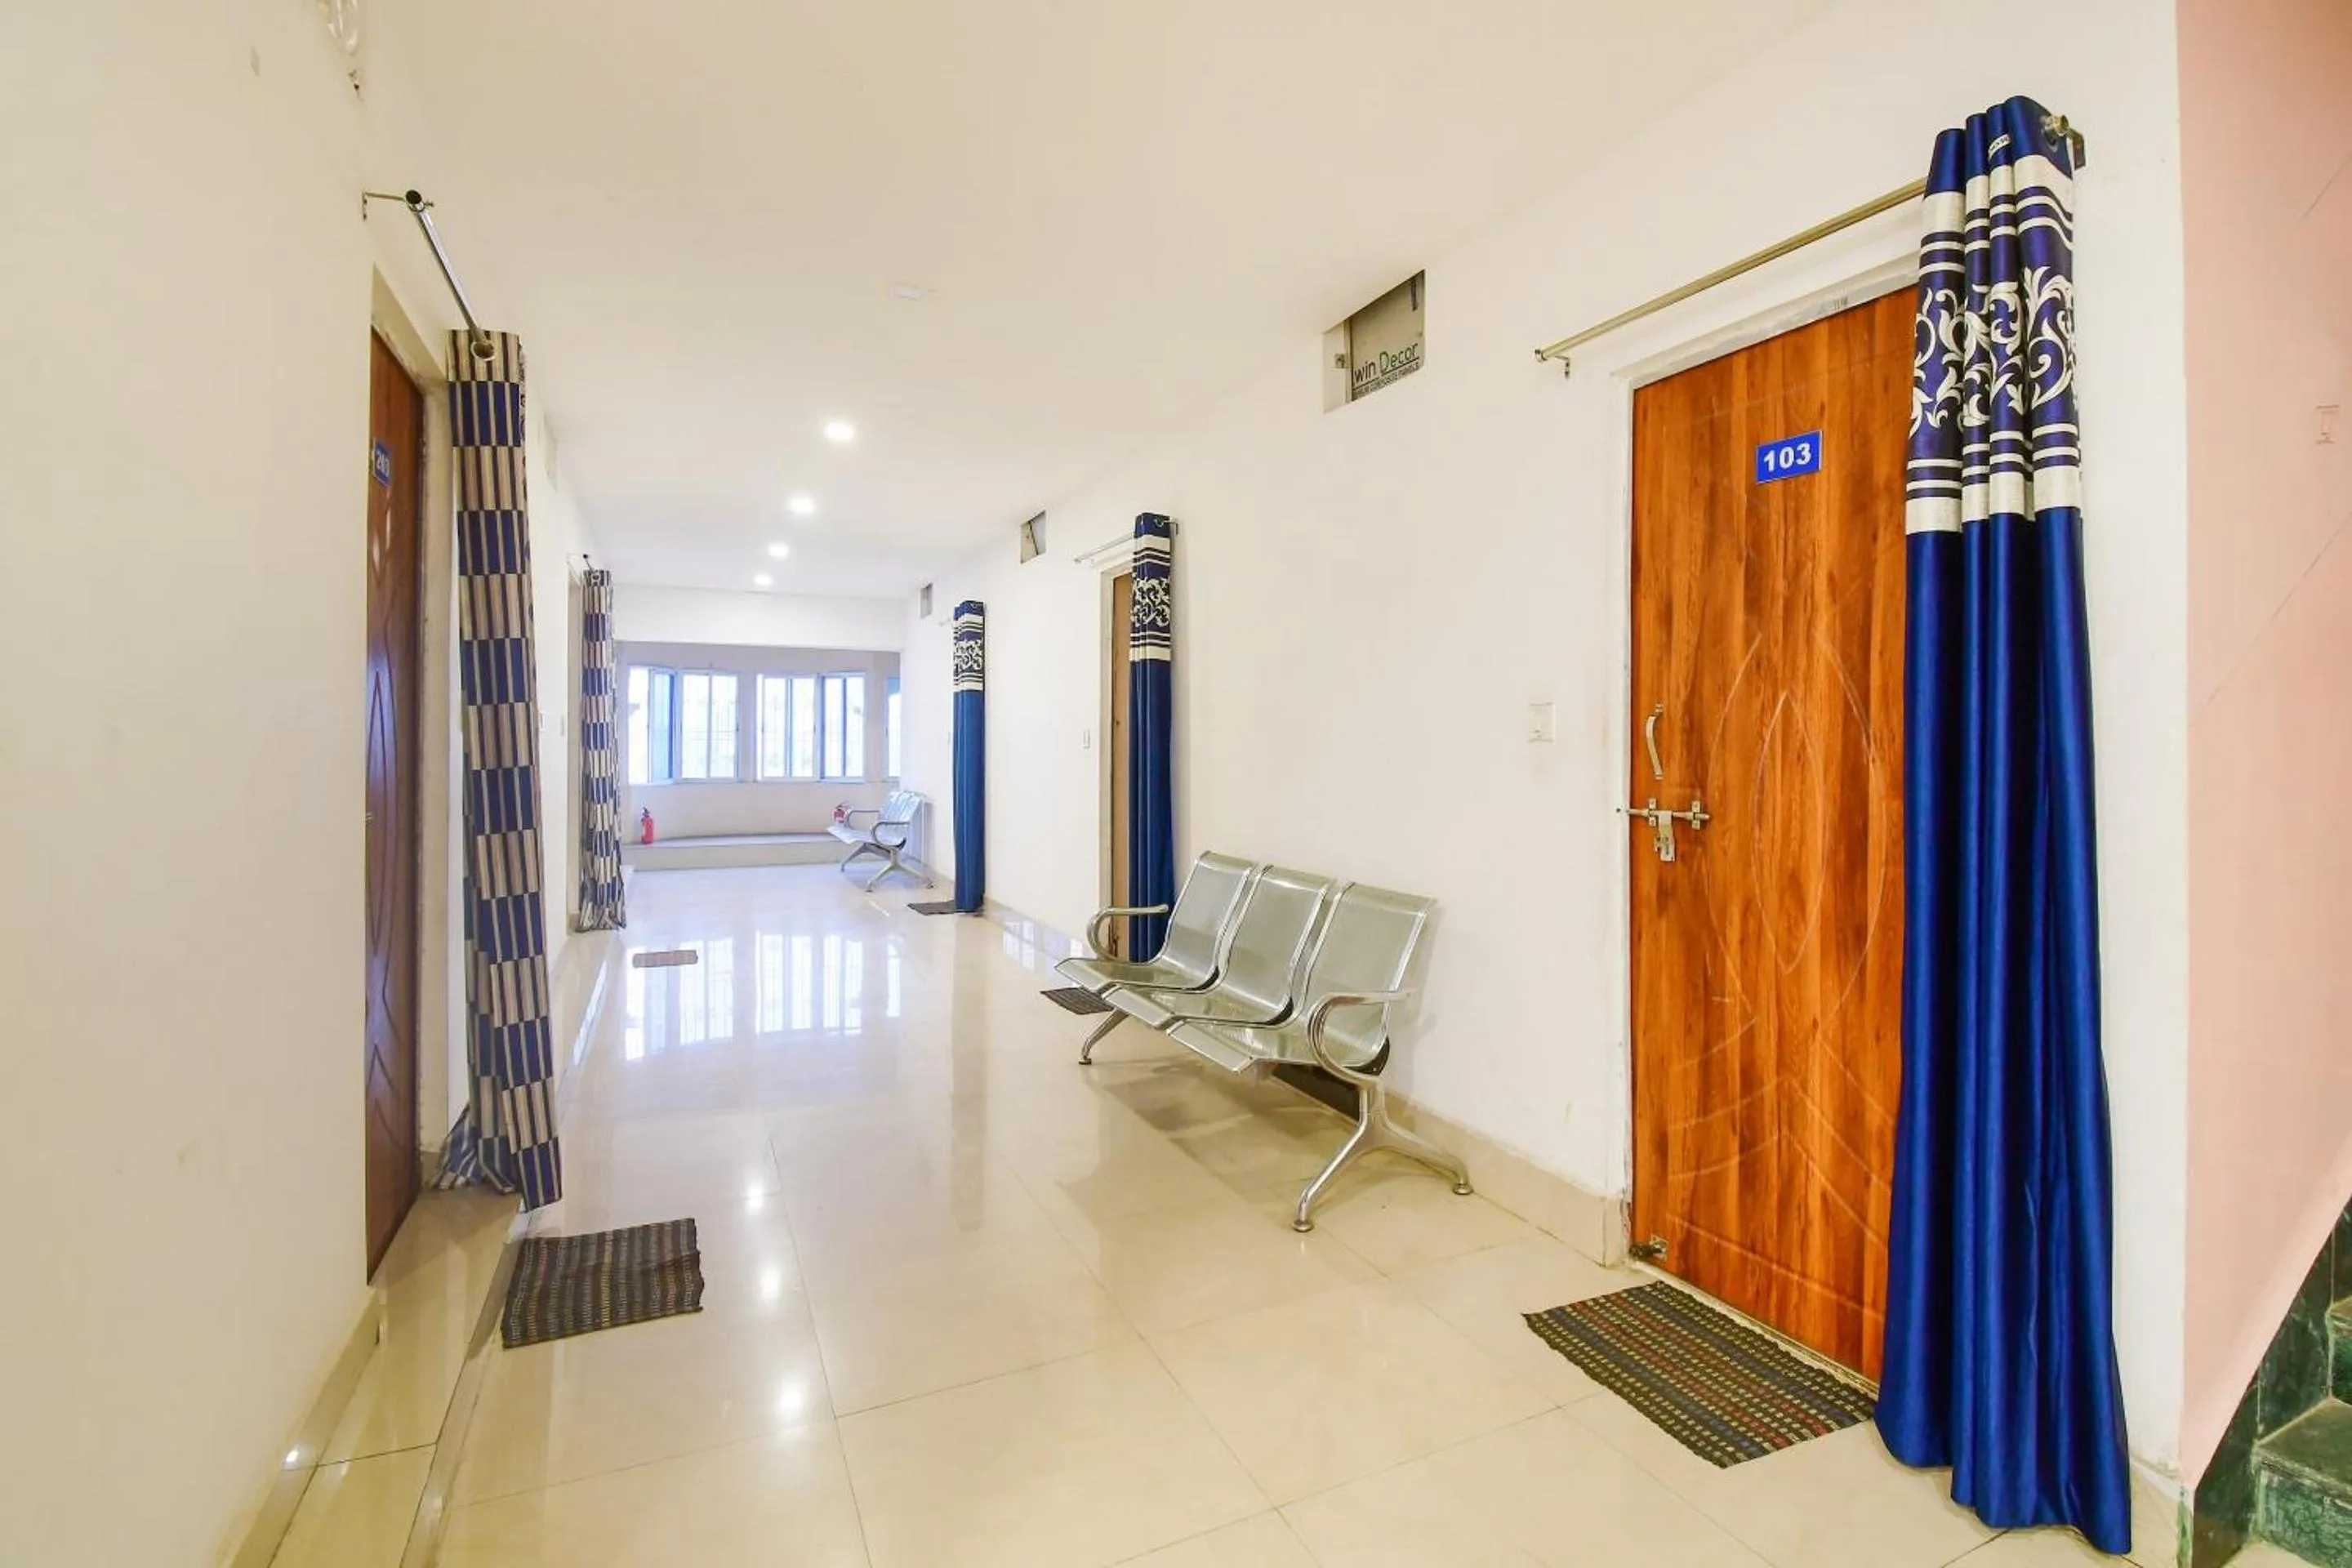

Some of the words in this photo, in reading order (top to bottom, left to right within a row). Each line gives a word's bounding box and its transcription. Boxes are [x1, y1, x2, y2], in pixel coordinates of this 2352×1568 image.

[1352, 360, 1377, 384] win
[1379, 343, 1419, 373] Decor
[1763, 442, 1812, 473] 103
